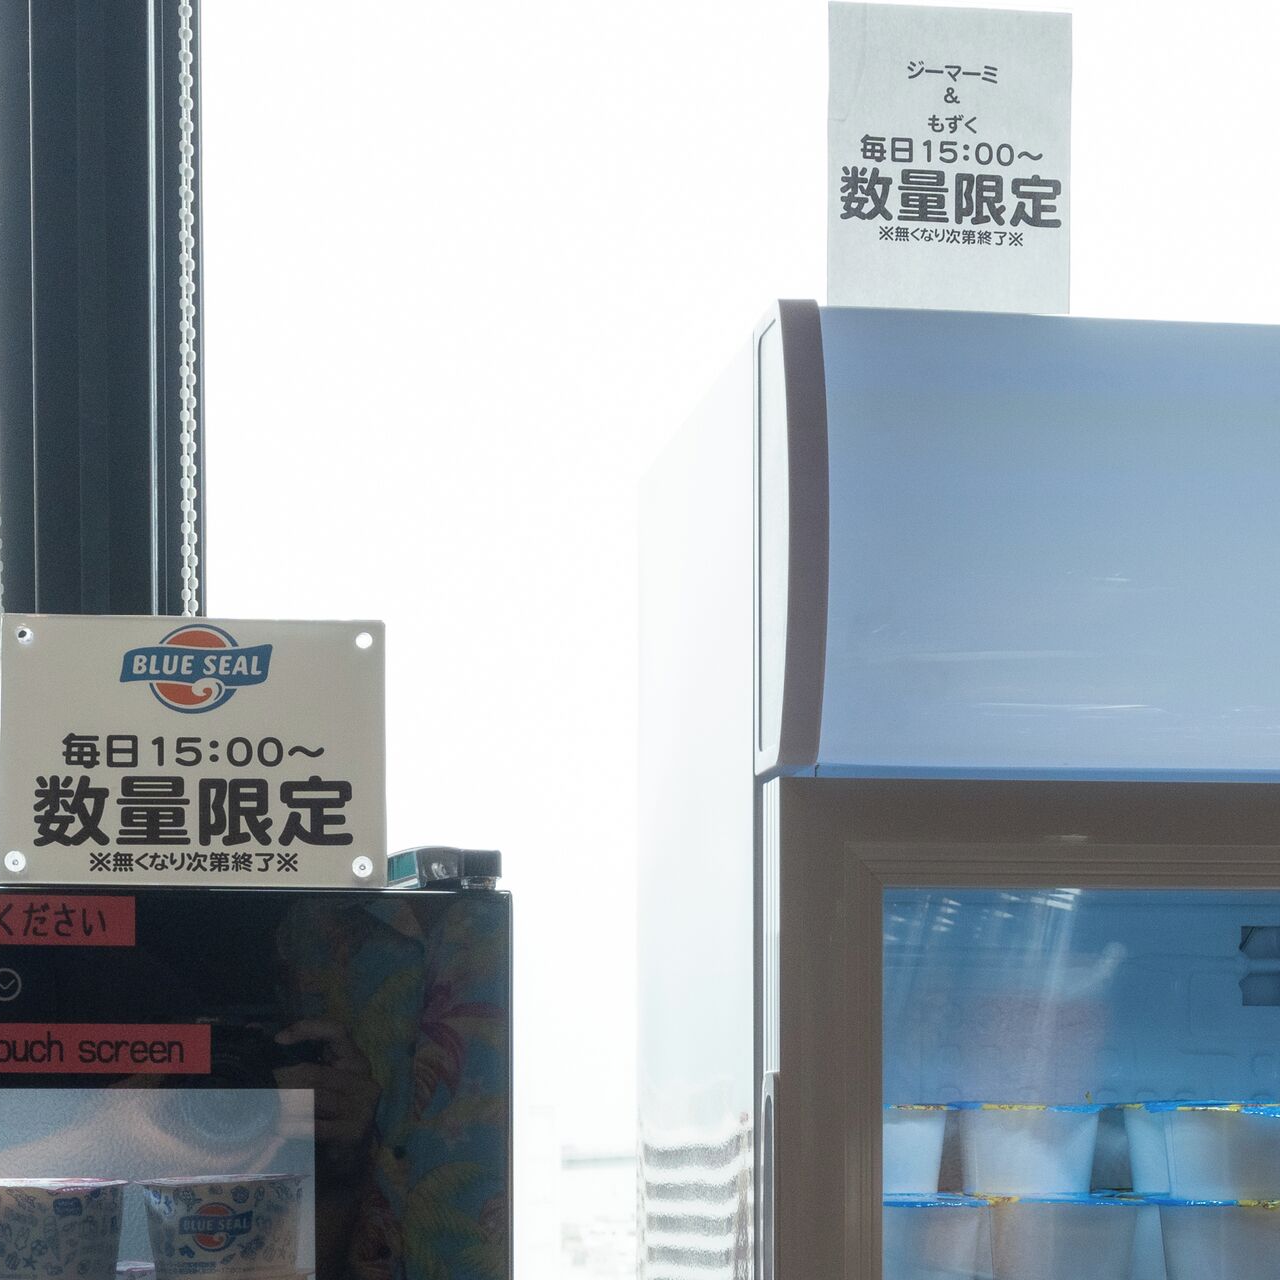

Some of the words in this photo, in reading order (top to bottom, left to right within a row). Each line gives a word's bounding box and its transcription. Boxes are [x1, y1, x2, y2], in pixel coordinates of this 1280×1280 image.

[907, 60, 998, 84] ジーマーミ
[943, 87, 960, 104] &
[927, 114, 977, 134] もずく
[840, 166, 1062, 228] 数量限定
[878, 225, 1024, 247] ※無くなり次第終了※
[132, 654, 193, 676] BLUE
[203, 654, 263, 676] SEAL
[33, 775, 354, 847] 数量限定
[89, 851, 298, 873] ※無くなり次第終了※
[78, 1039, 185, 1065] screen
